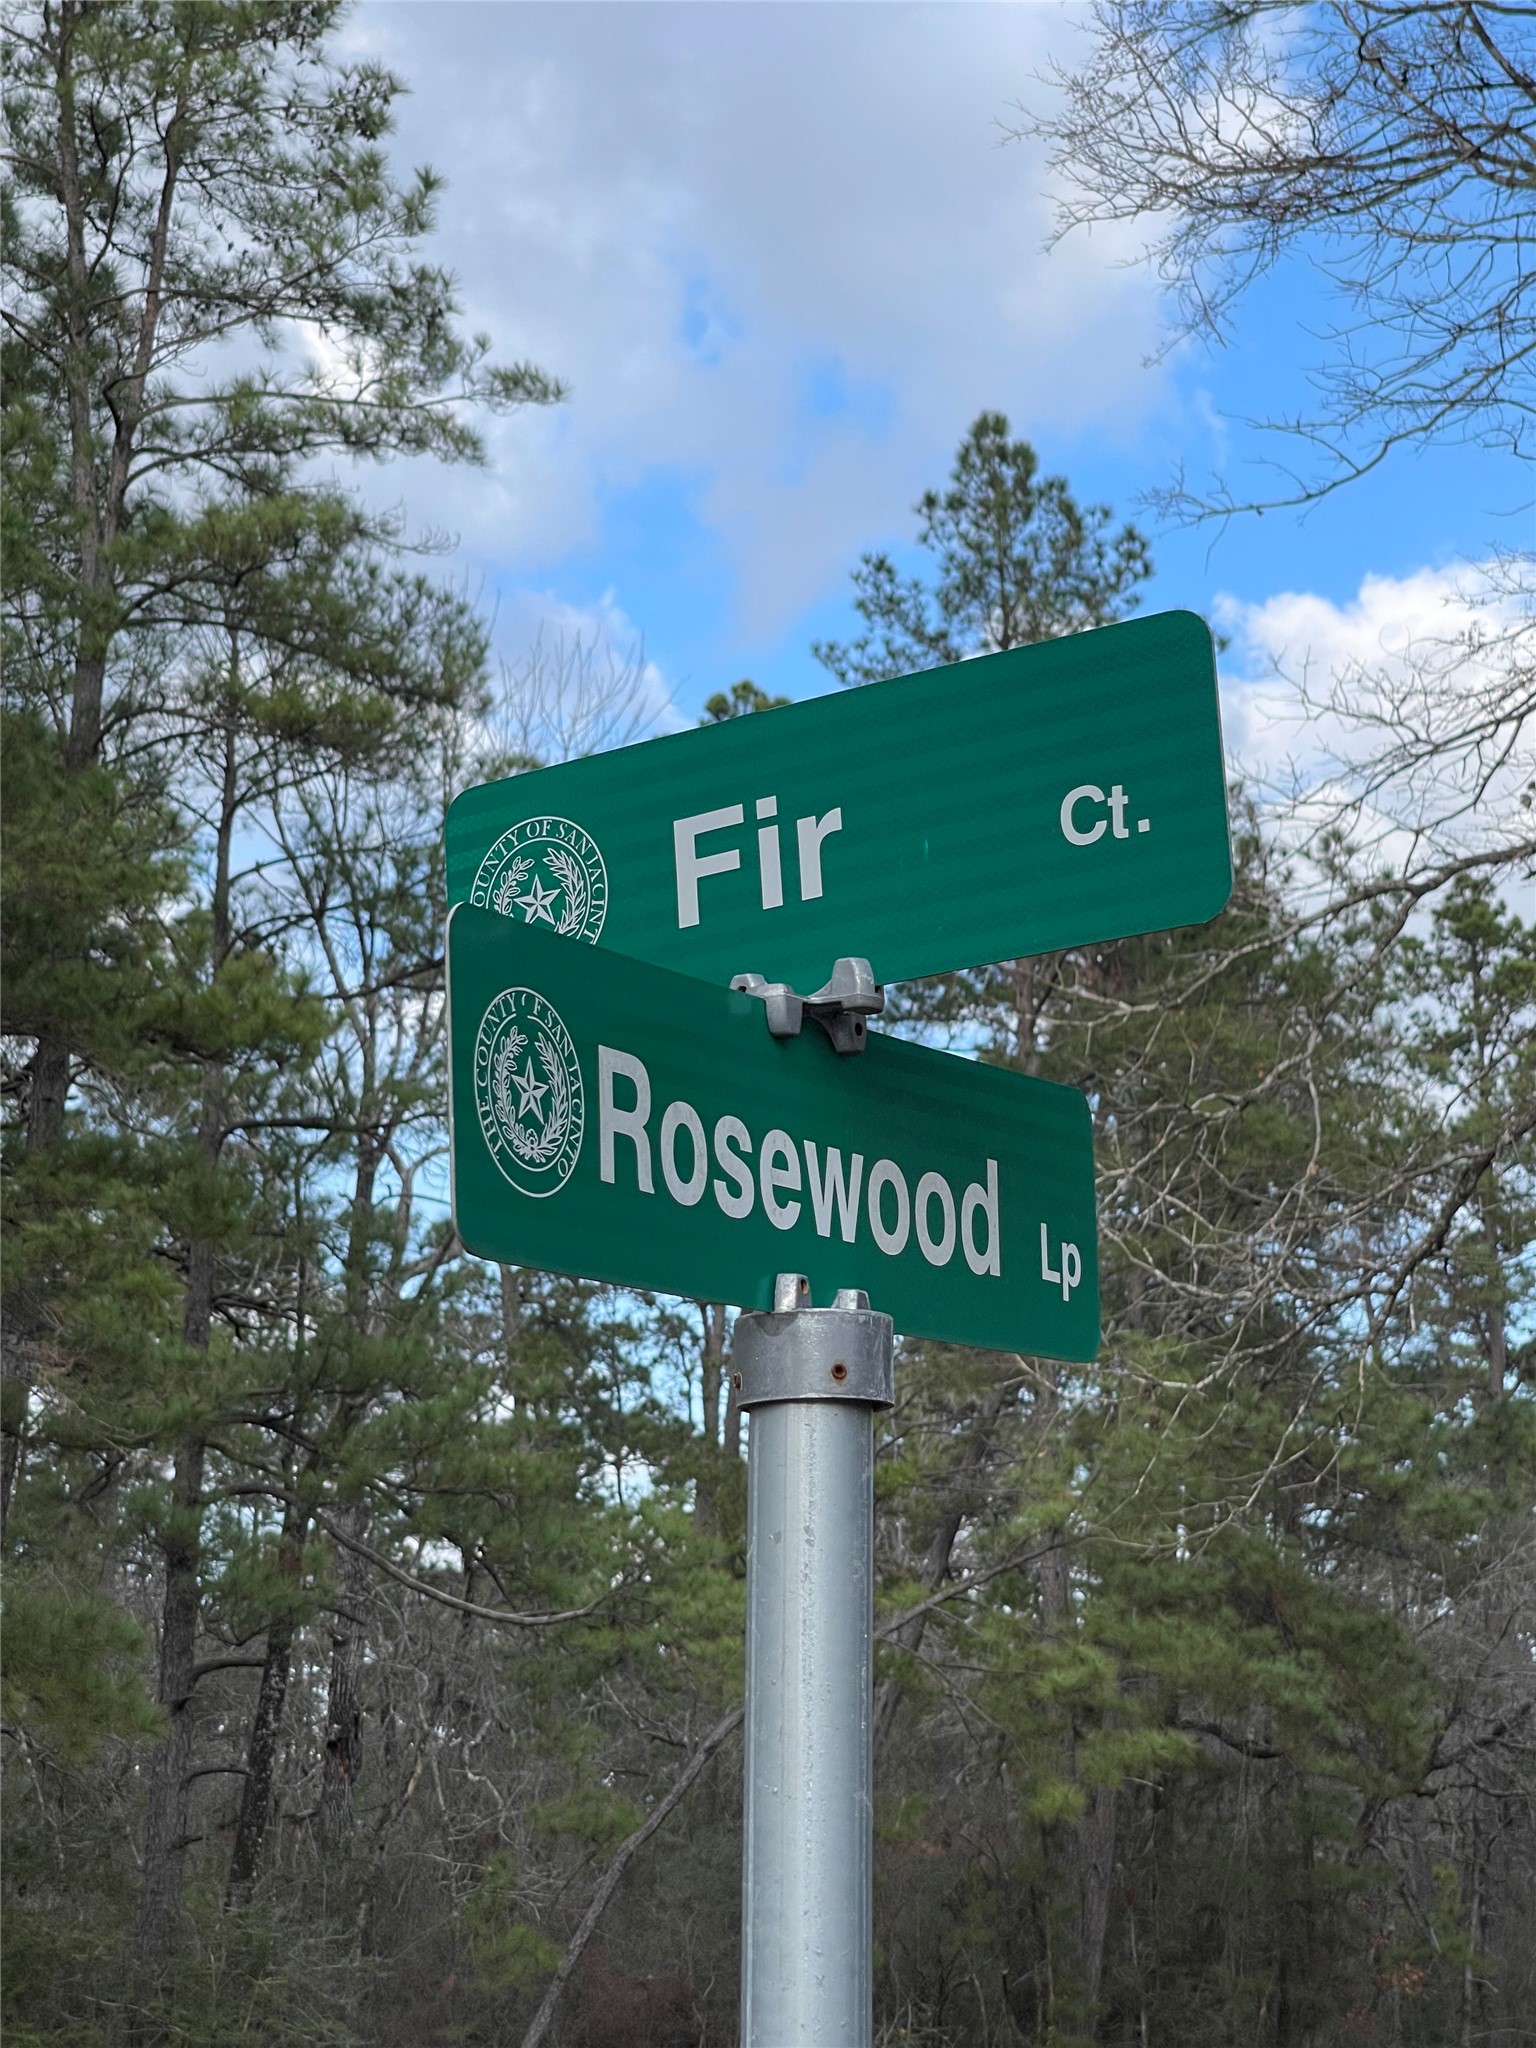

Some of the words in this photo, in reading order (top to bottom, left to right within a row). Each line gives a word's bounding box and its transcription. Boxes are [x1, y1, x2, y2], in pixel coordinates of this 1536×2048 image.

[473, 829, 520, 908] OUNTY
[526, 819, 553, 837] OF
[555, 821, 593, 856] SAN
[583, 855, 606, 944] JACINT
[673, 795, 843, 929] Fir
[1060, 784, 1150, 846] Ct.
[476, 992, 517, 1087] COUNTY
[544, 1010, 574, 1058] SAN
[479, 1099, 503, 1160] THE
[557, 1062, 583, 1178] JACINTO
[598, 1044, 1002, 1277] Rosewood
[1040, 1222, 1082, 1302] Lp
